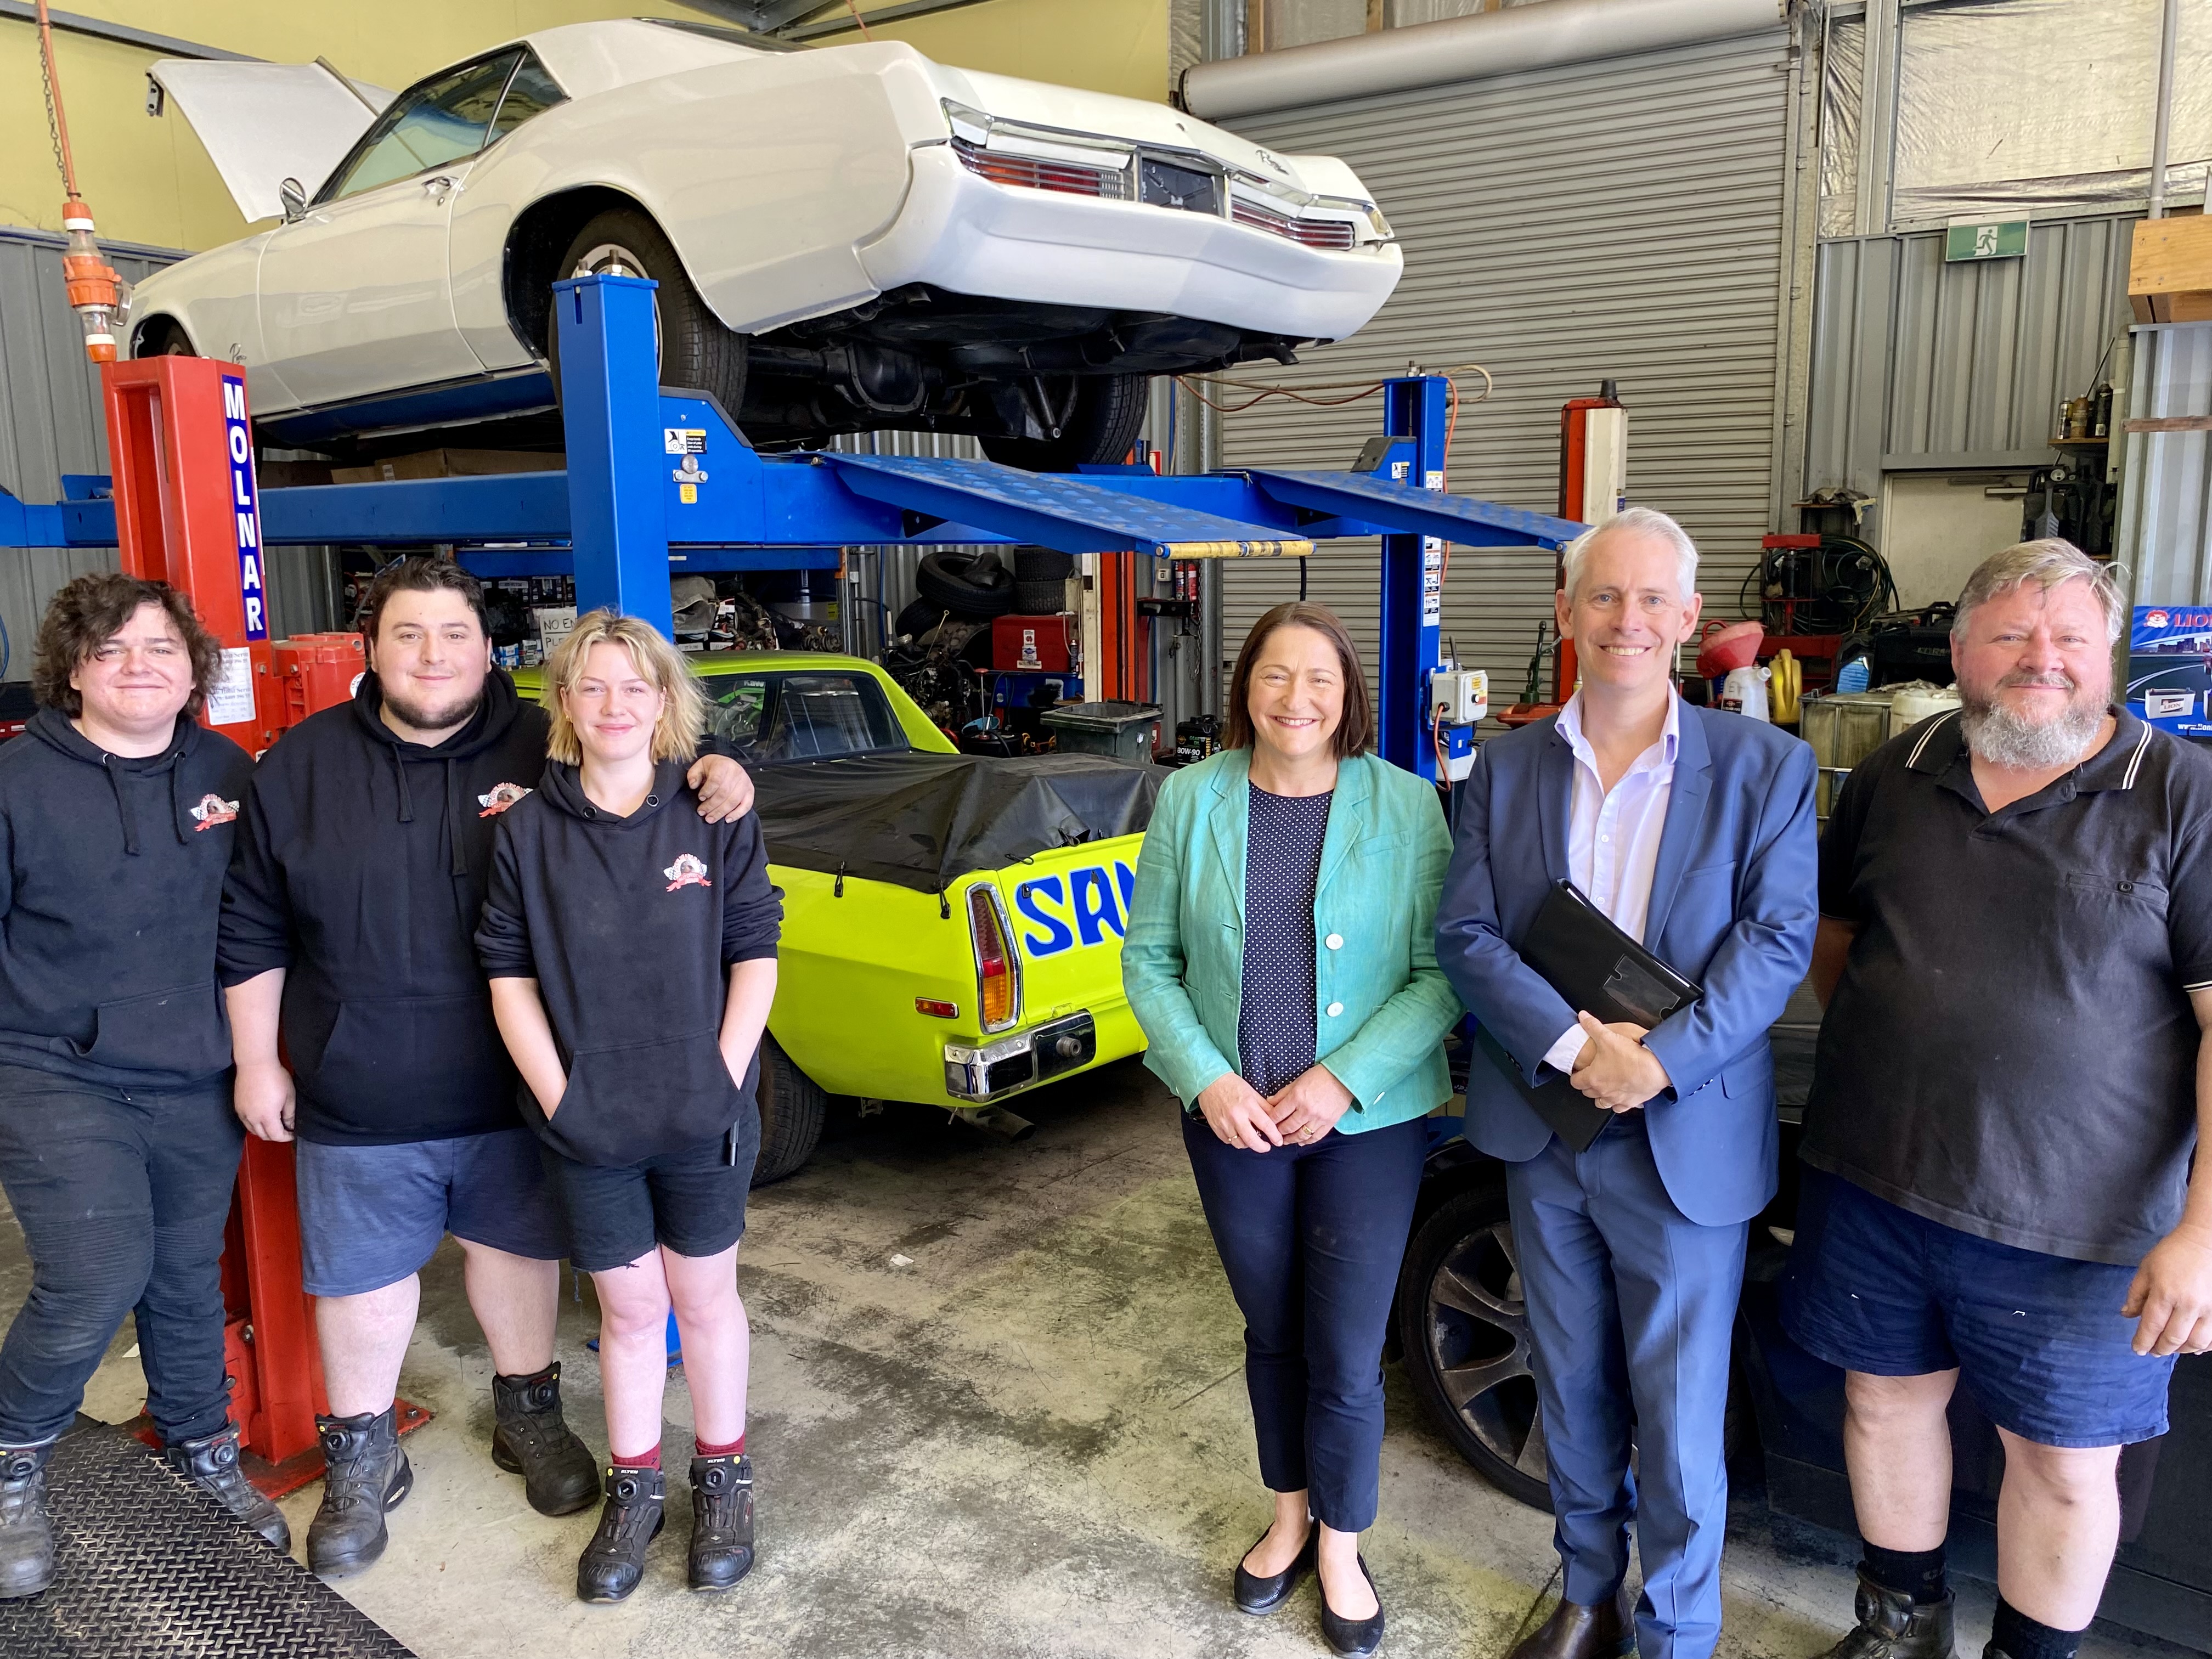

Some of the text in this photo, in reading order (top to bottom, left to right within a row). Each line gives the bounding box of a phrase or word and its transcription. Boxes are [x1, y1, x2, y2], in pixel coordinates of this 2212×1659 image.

[223, 382, 264, 632] MOLNAR
[544, 619, 559, 630] NO
[1177, 747, 1200, 756] 80W-90
